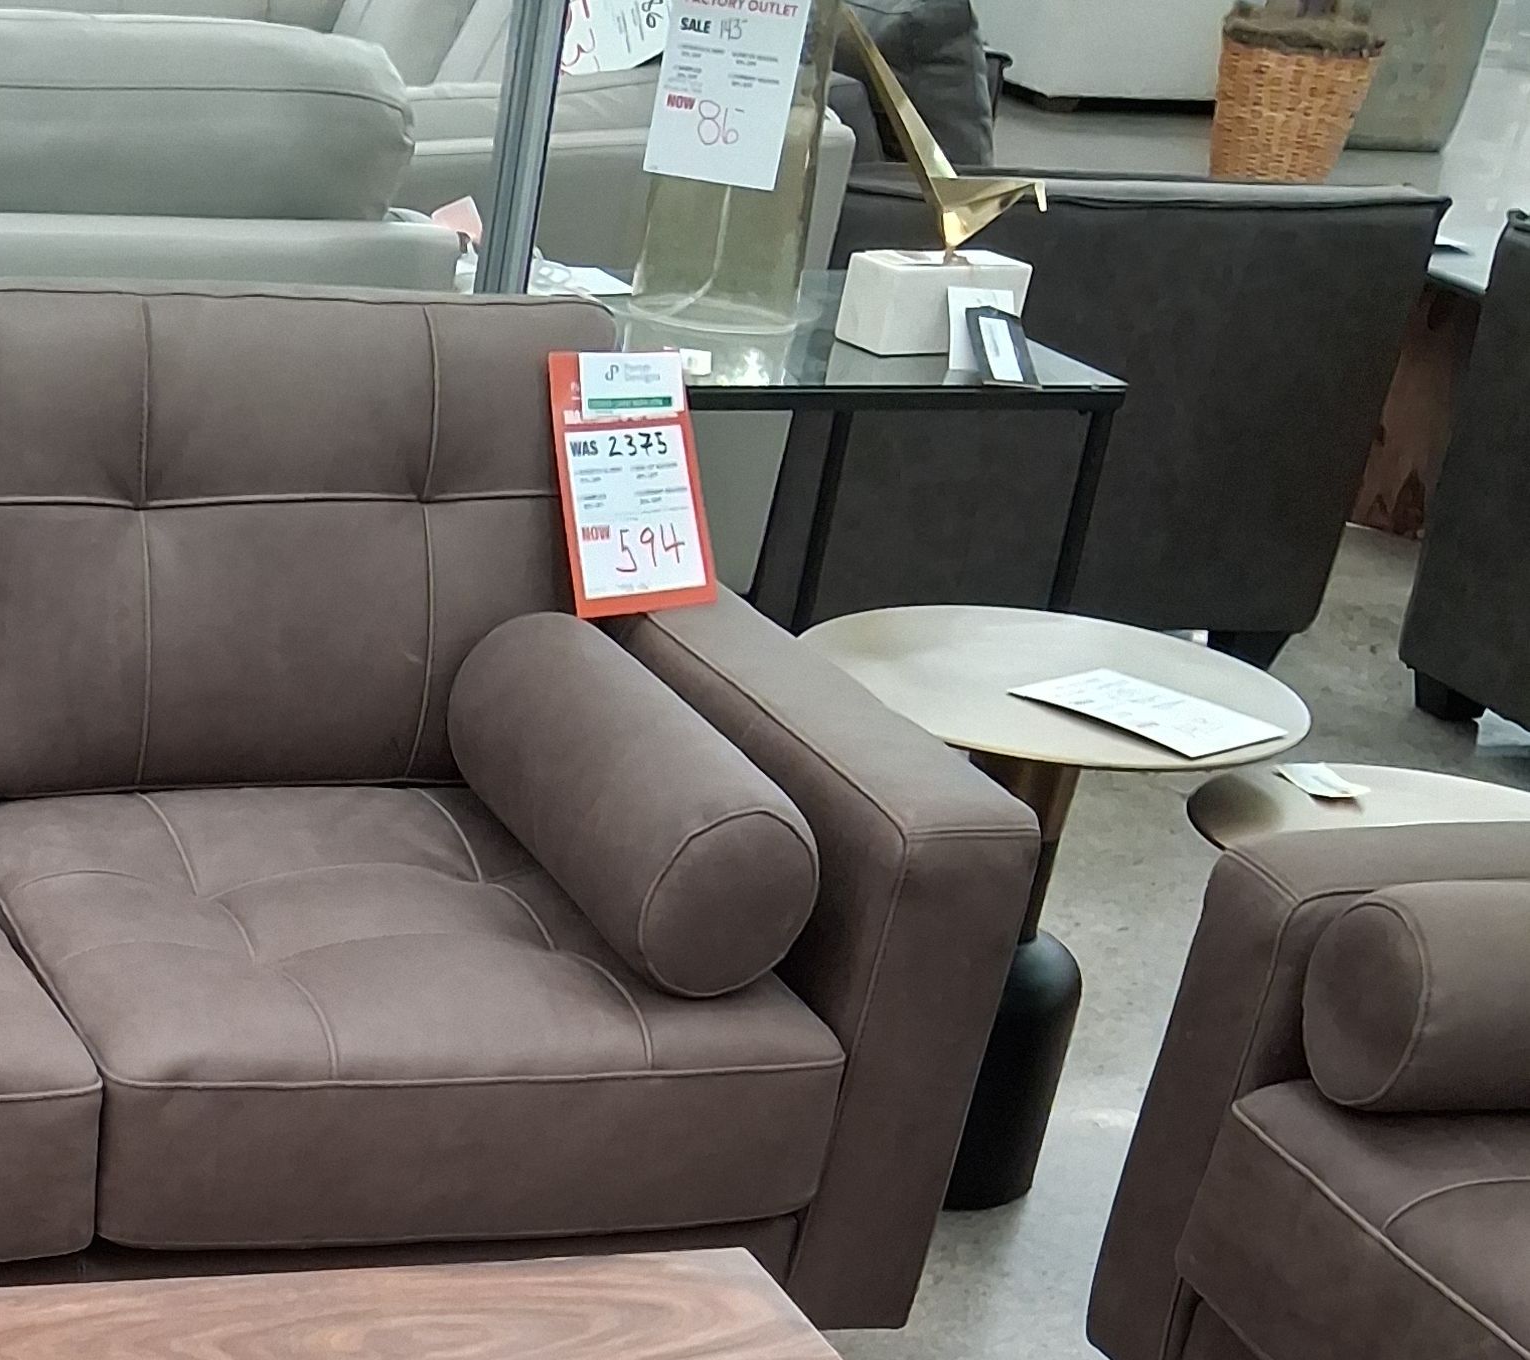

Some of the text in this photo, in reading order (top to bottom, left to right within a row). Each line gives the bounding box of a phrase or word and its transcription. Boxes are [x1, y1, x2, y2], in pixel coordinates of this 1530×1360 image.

[748, 0, 799, 17] OUTLET
[680, 17, 712, 34] SALE
[666, 93, 696, 110] NOW
[570, 432, 668, 457] WAS 2375
[581, 523, 686, 573] NOW 594
